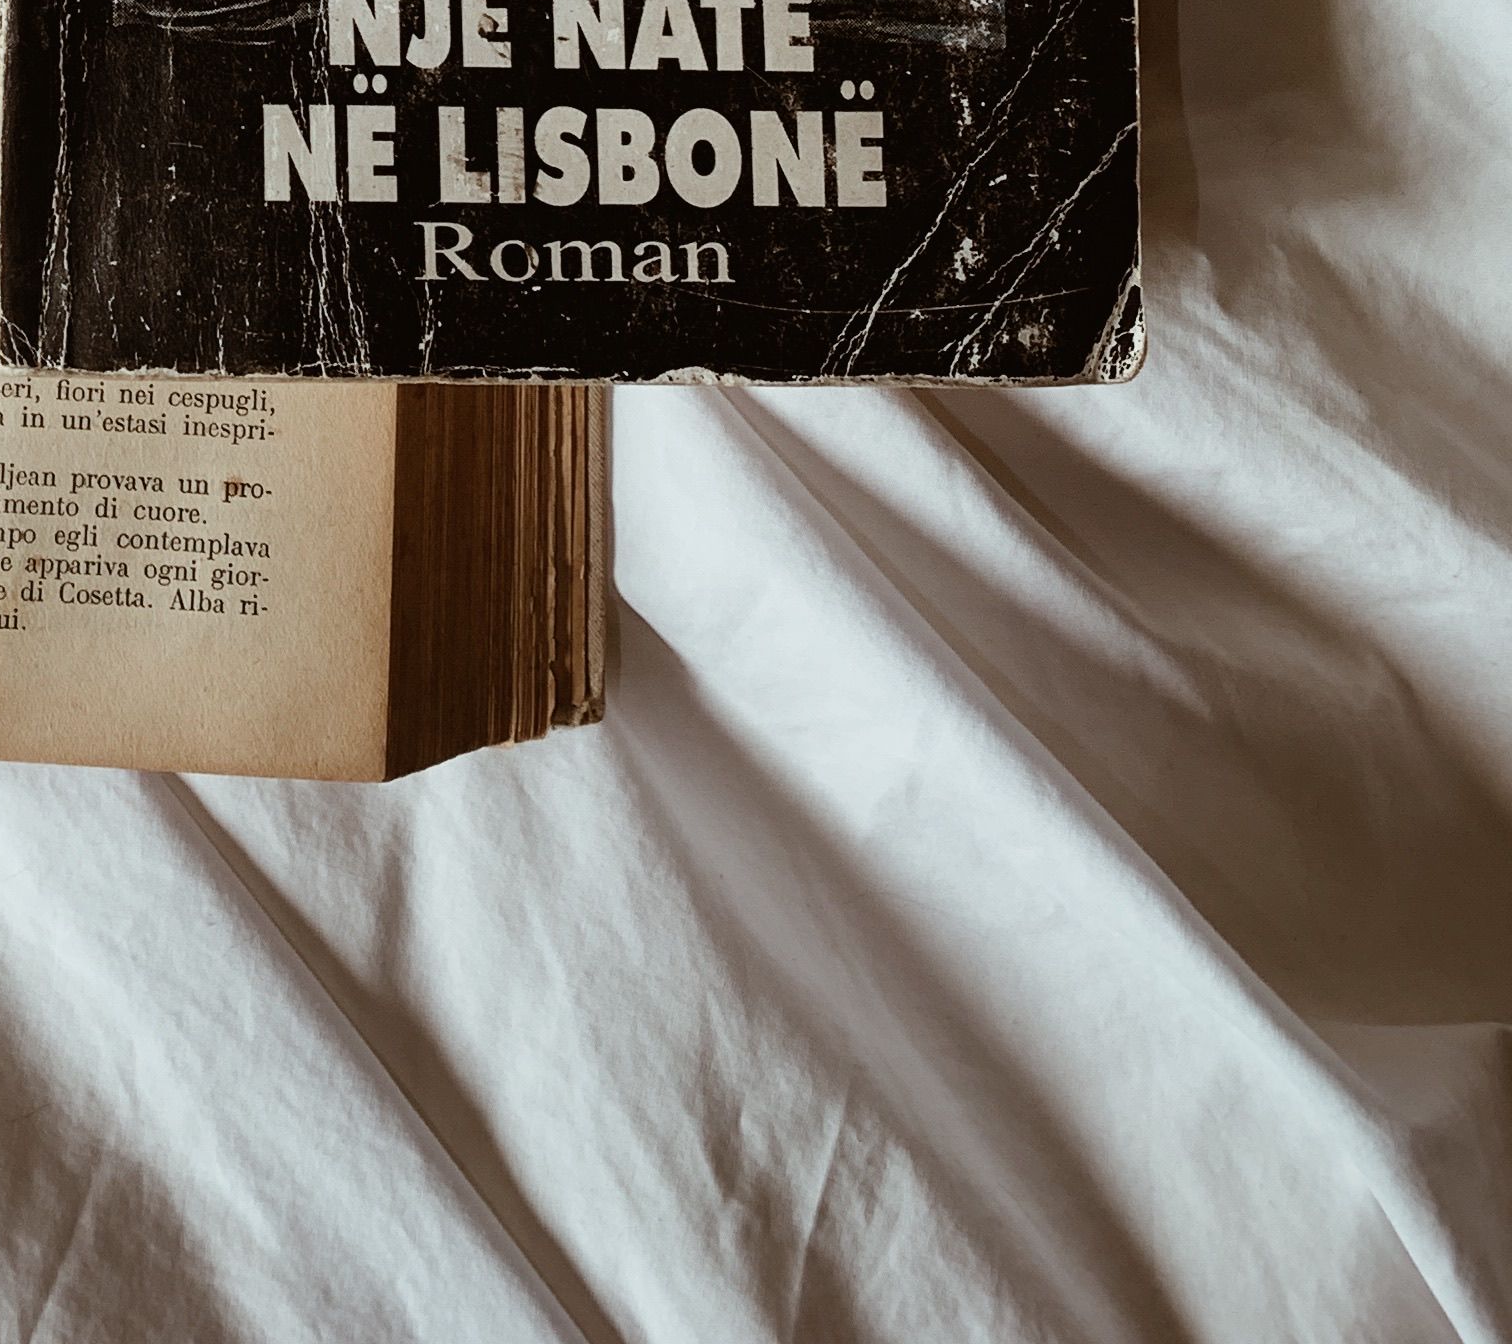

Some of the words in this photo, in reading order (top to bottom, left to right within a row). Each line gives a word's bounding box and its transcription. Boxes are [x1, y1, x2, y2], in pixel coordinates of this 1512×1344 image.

[262, 73, 398, 202] NË
[437, 79, 888, 207] LISBONË
[413, 221, 737, 284] Roman
[57, 379, 104, 402] fiori
[119, 384, 154, 405] nei
[169, 389, 275, 418] cespugli,
[70, 473, 164, 494] provava
[179, 479, 208, 495] un
[223, 476, 271, 503] pro-
